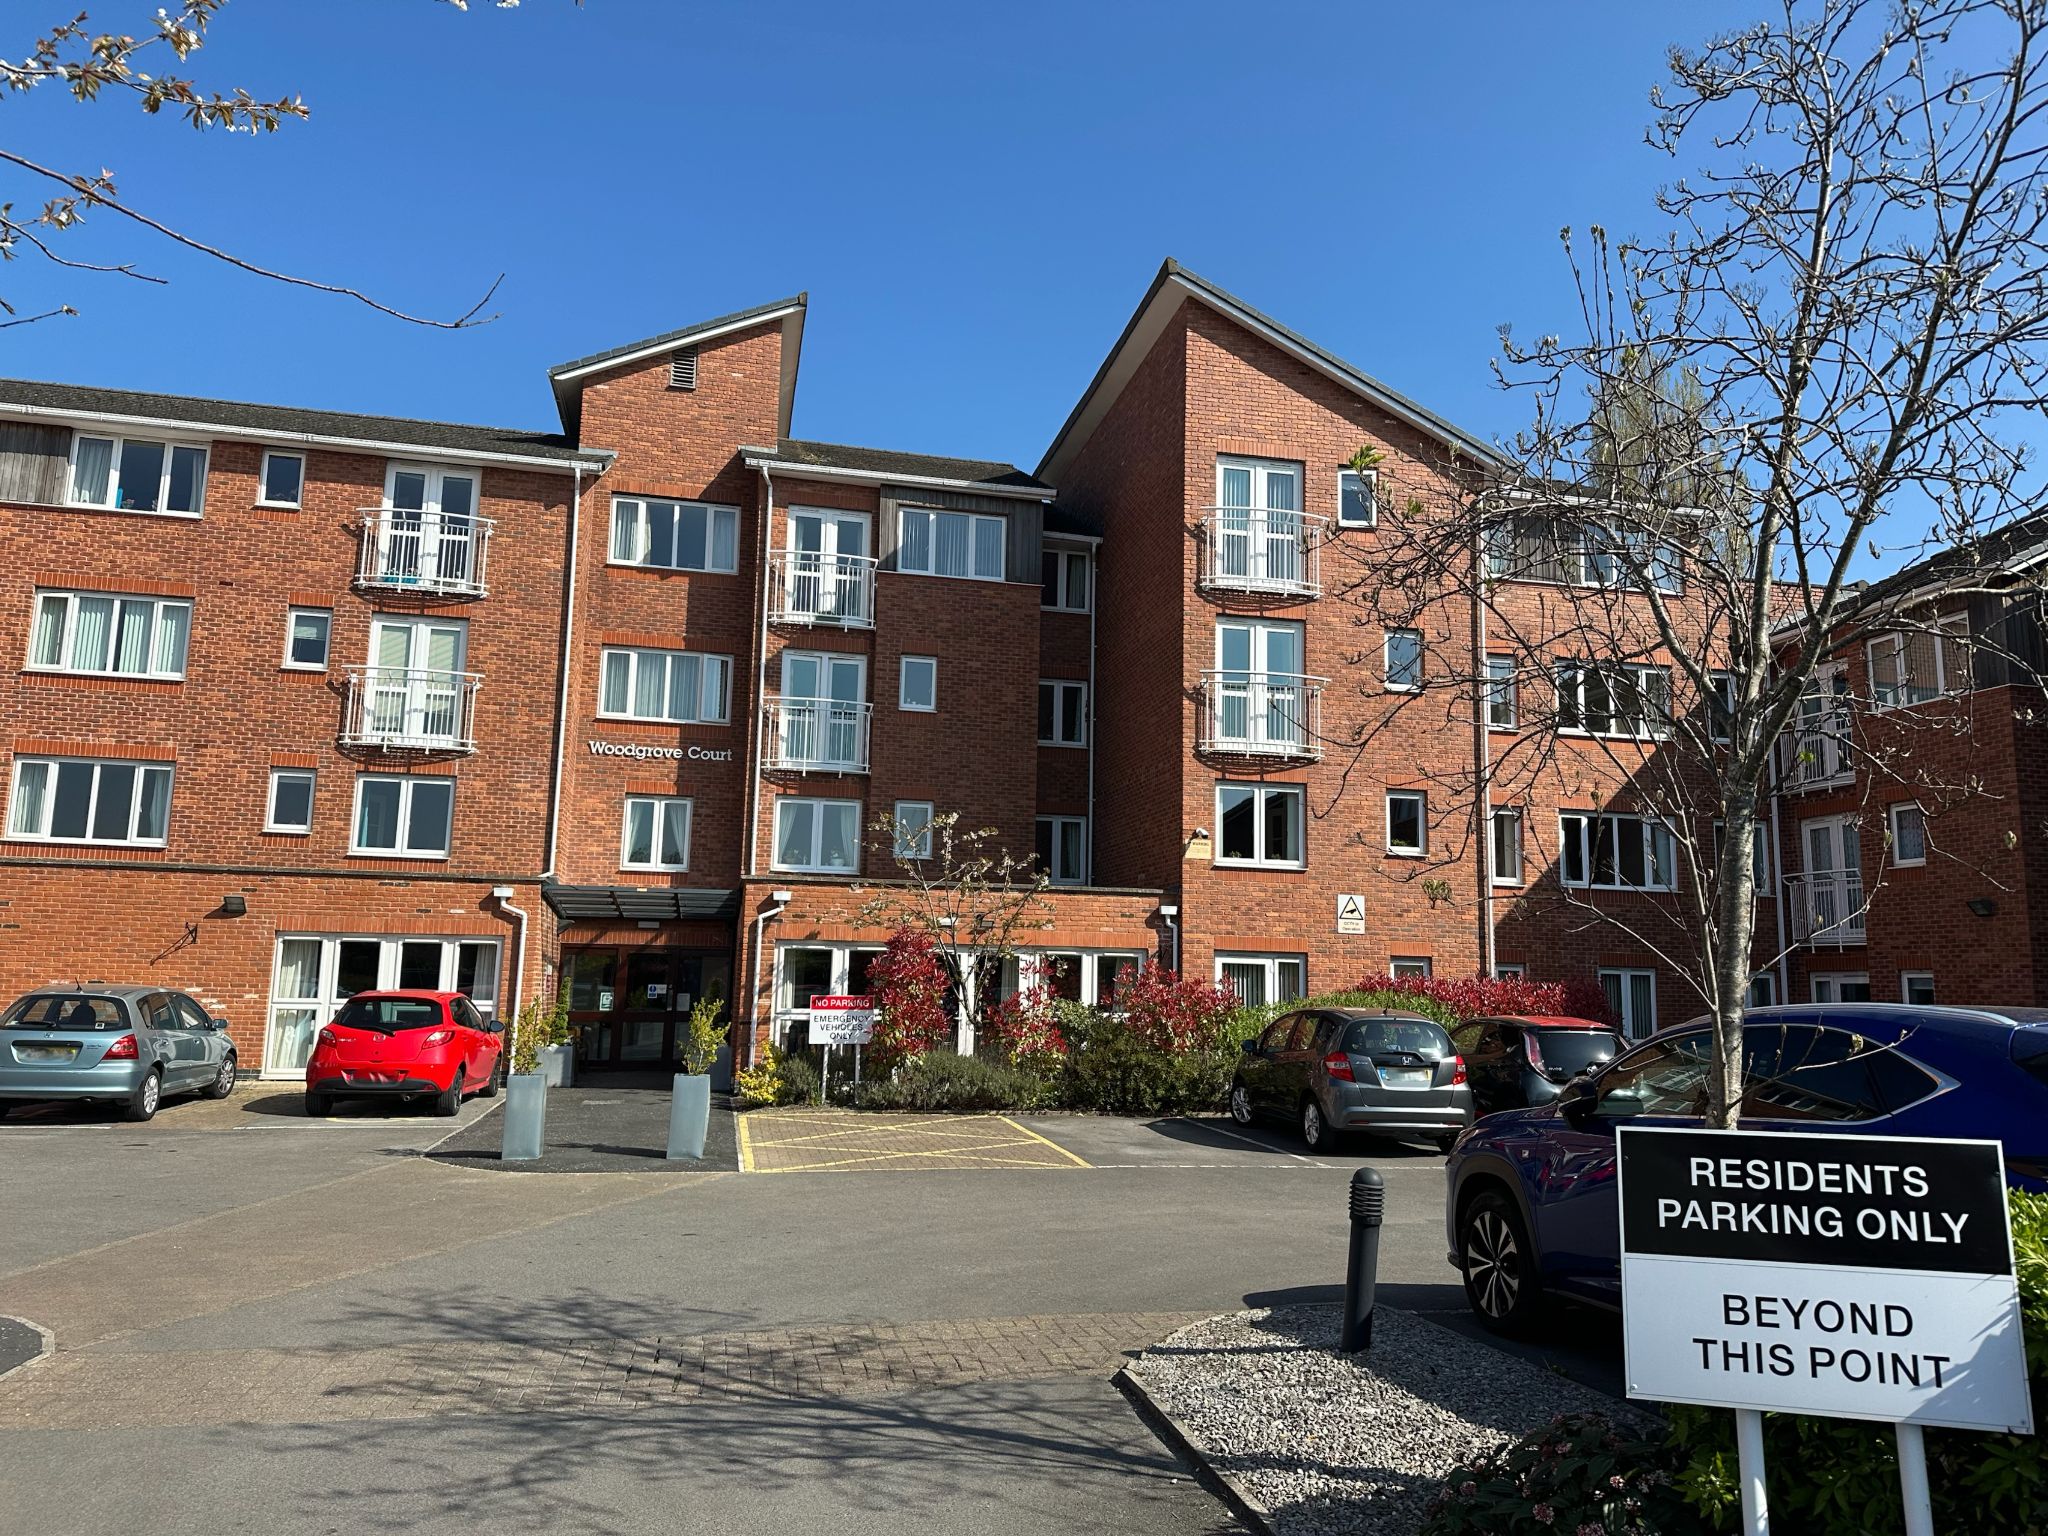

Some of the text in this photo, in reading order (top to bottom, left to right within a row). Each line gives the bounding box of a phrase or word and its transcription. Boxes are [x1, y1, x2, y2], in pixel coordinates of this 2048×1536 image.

[588, 740, 733, 761] Woodgrove Court
[815, 999, 870, 1007] NO PARKING
[814, 1015, 870, 1023] EMERGENCY
[820, 1023, 863, 1031] VEHICLES
[829, 1032, 853, 1040] ONLY
[1690, 1156, 1930, 1198] RESIDENTS
[1657, 1198, 1970, 1244] PARKING ONLY
[1722, 1293, 1913, 1338] BEYOND
[1692, 1338, 1951, 1389] THIS POINT
